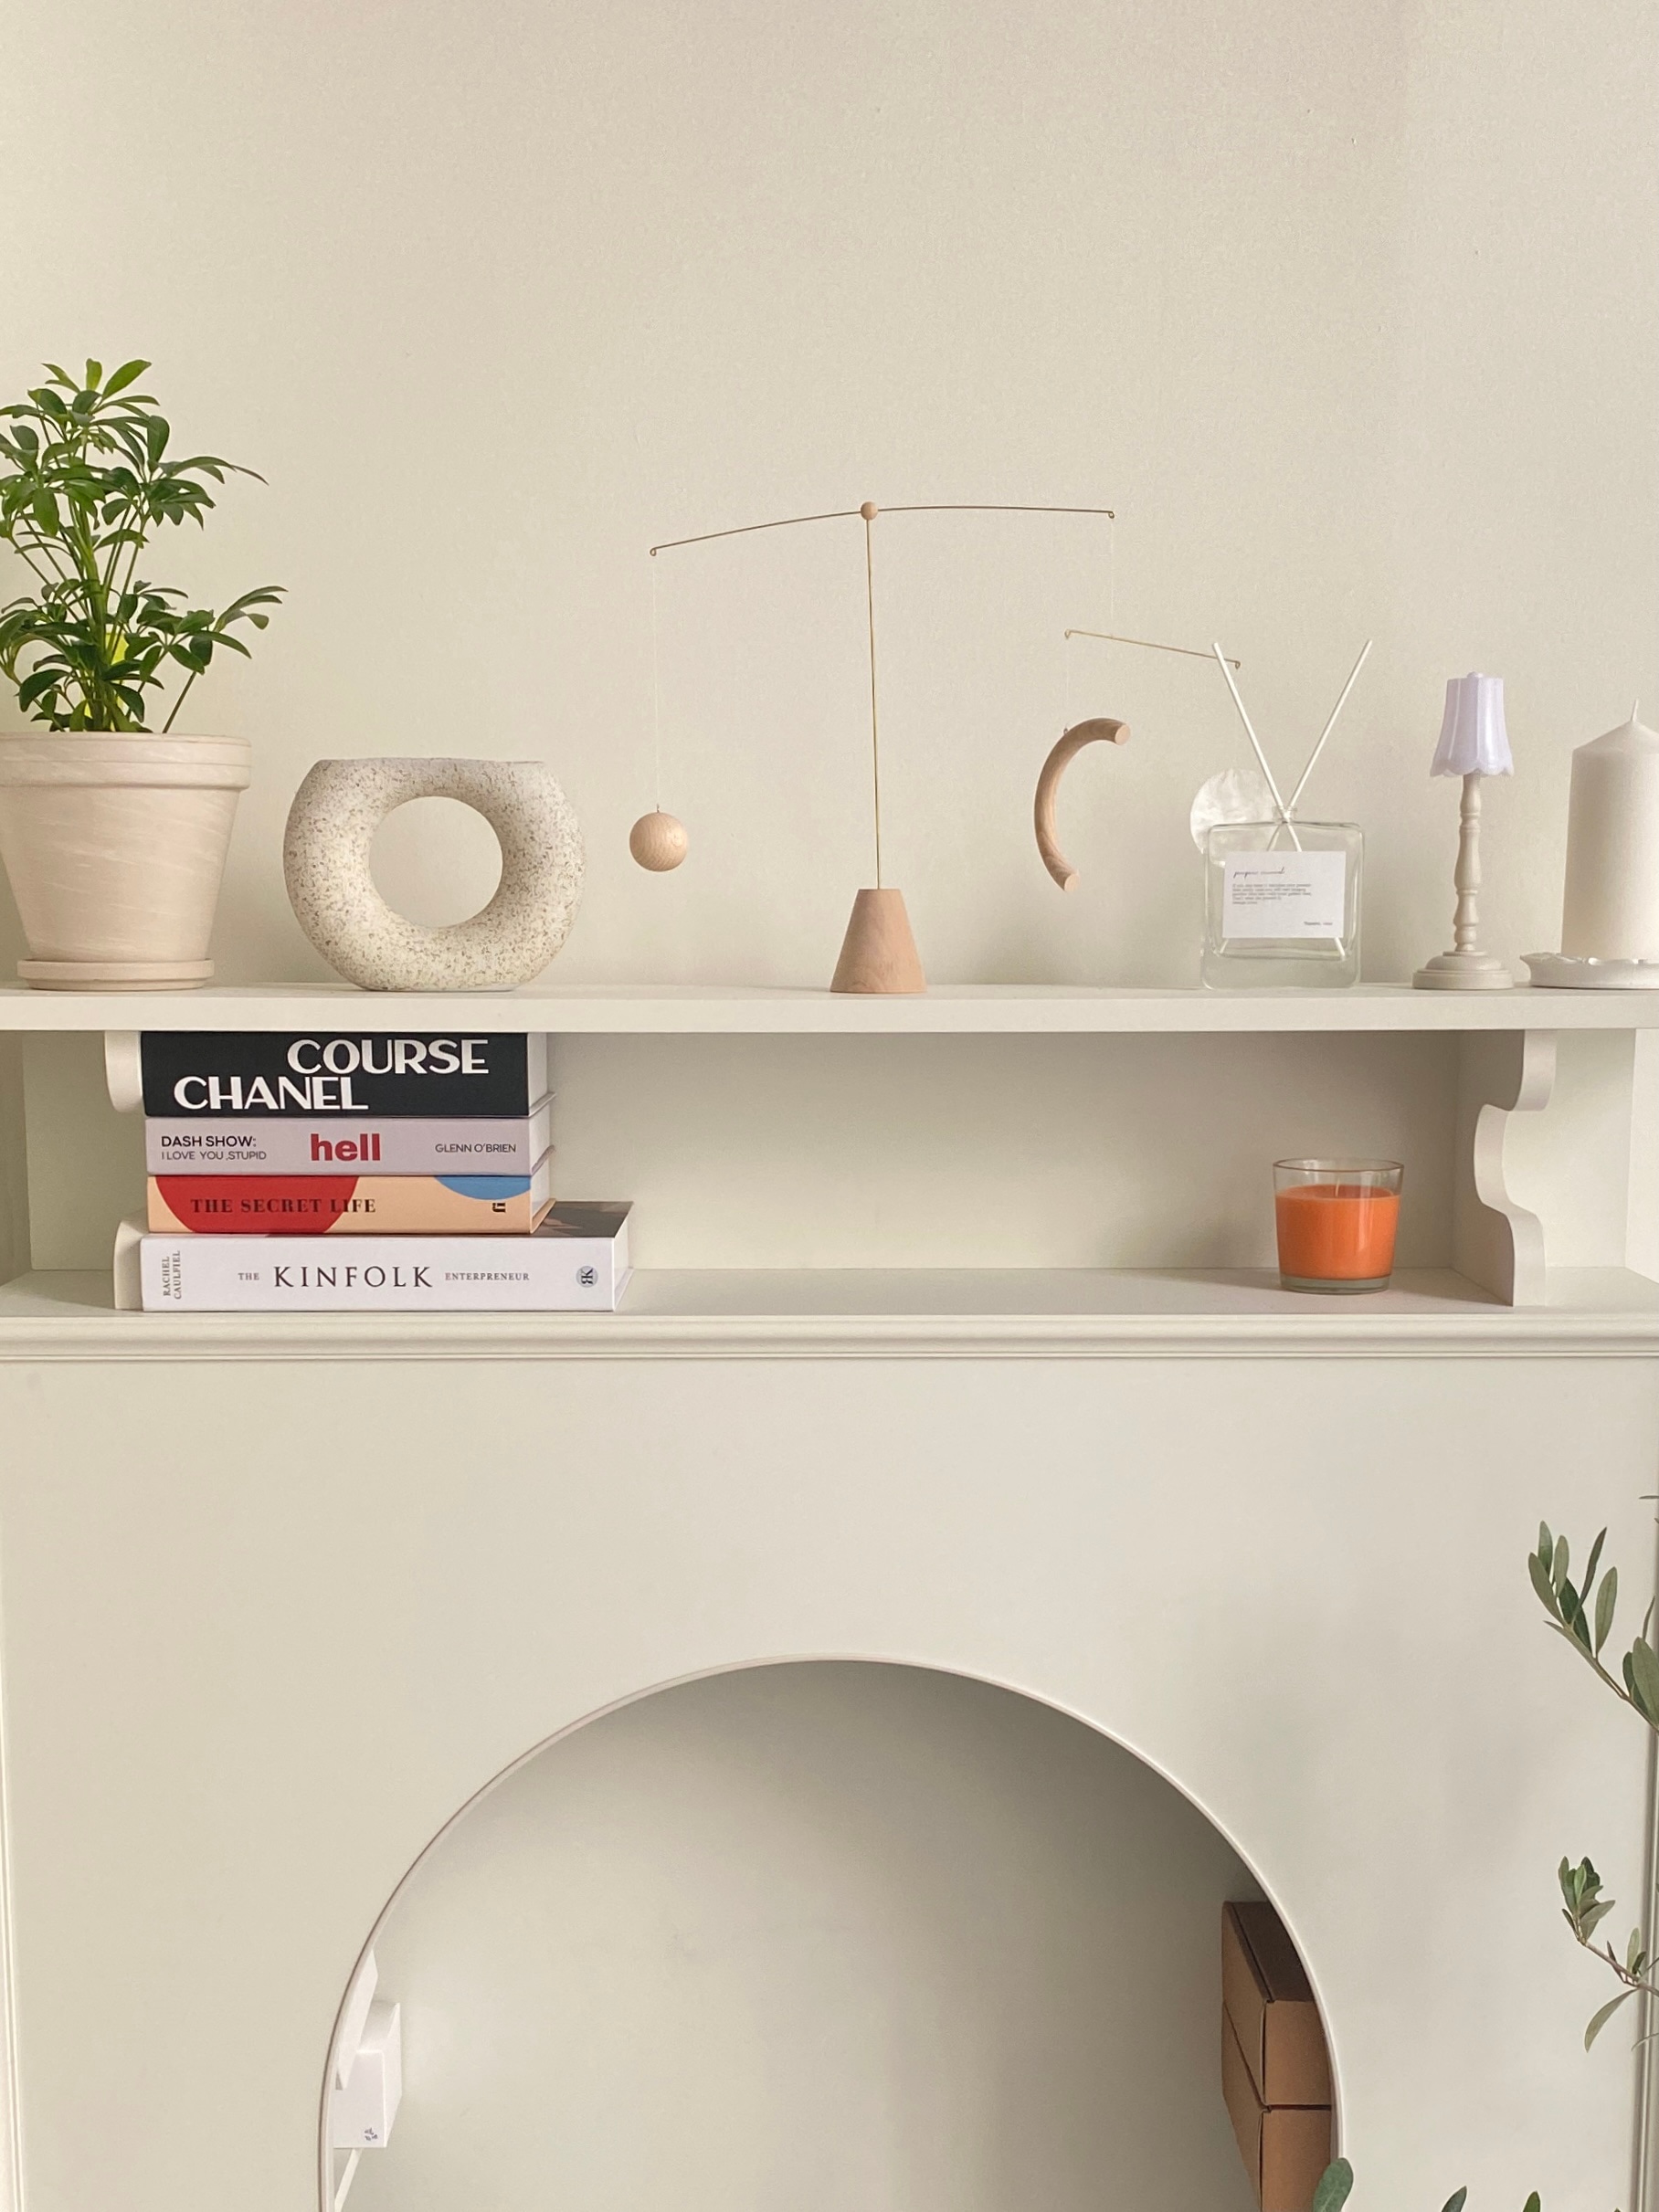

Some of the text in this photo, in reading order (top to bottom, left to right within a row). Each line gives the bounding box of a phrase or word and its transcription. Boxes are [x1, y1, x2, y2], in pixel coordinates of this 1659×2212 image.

[287, 1039, 490, 1075] COURSE
[174, 1076, 369, 1110] CHANEL
[161, 1135, 257, 1148] DASH SHOW:
[310, 1132, 381, 1162] hell
[435, 1143, 517, 1153] GLENN O'BRIEN
[161, 1151, 164, 1160] I
[166, 1151, 195, 1161] LOVE
[199, 1151, 224, 1160] YOU
[190, 1198, 376, 1214] THE SECRET LIFE
[162, 1256, 171, 1296] RACHEL
[238, 1266, 530, 1288] THE KINFOLK ENTERPRENEUR
